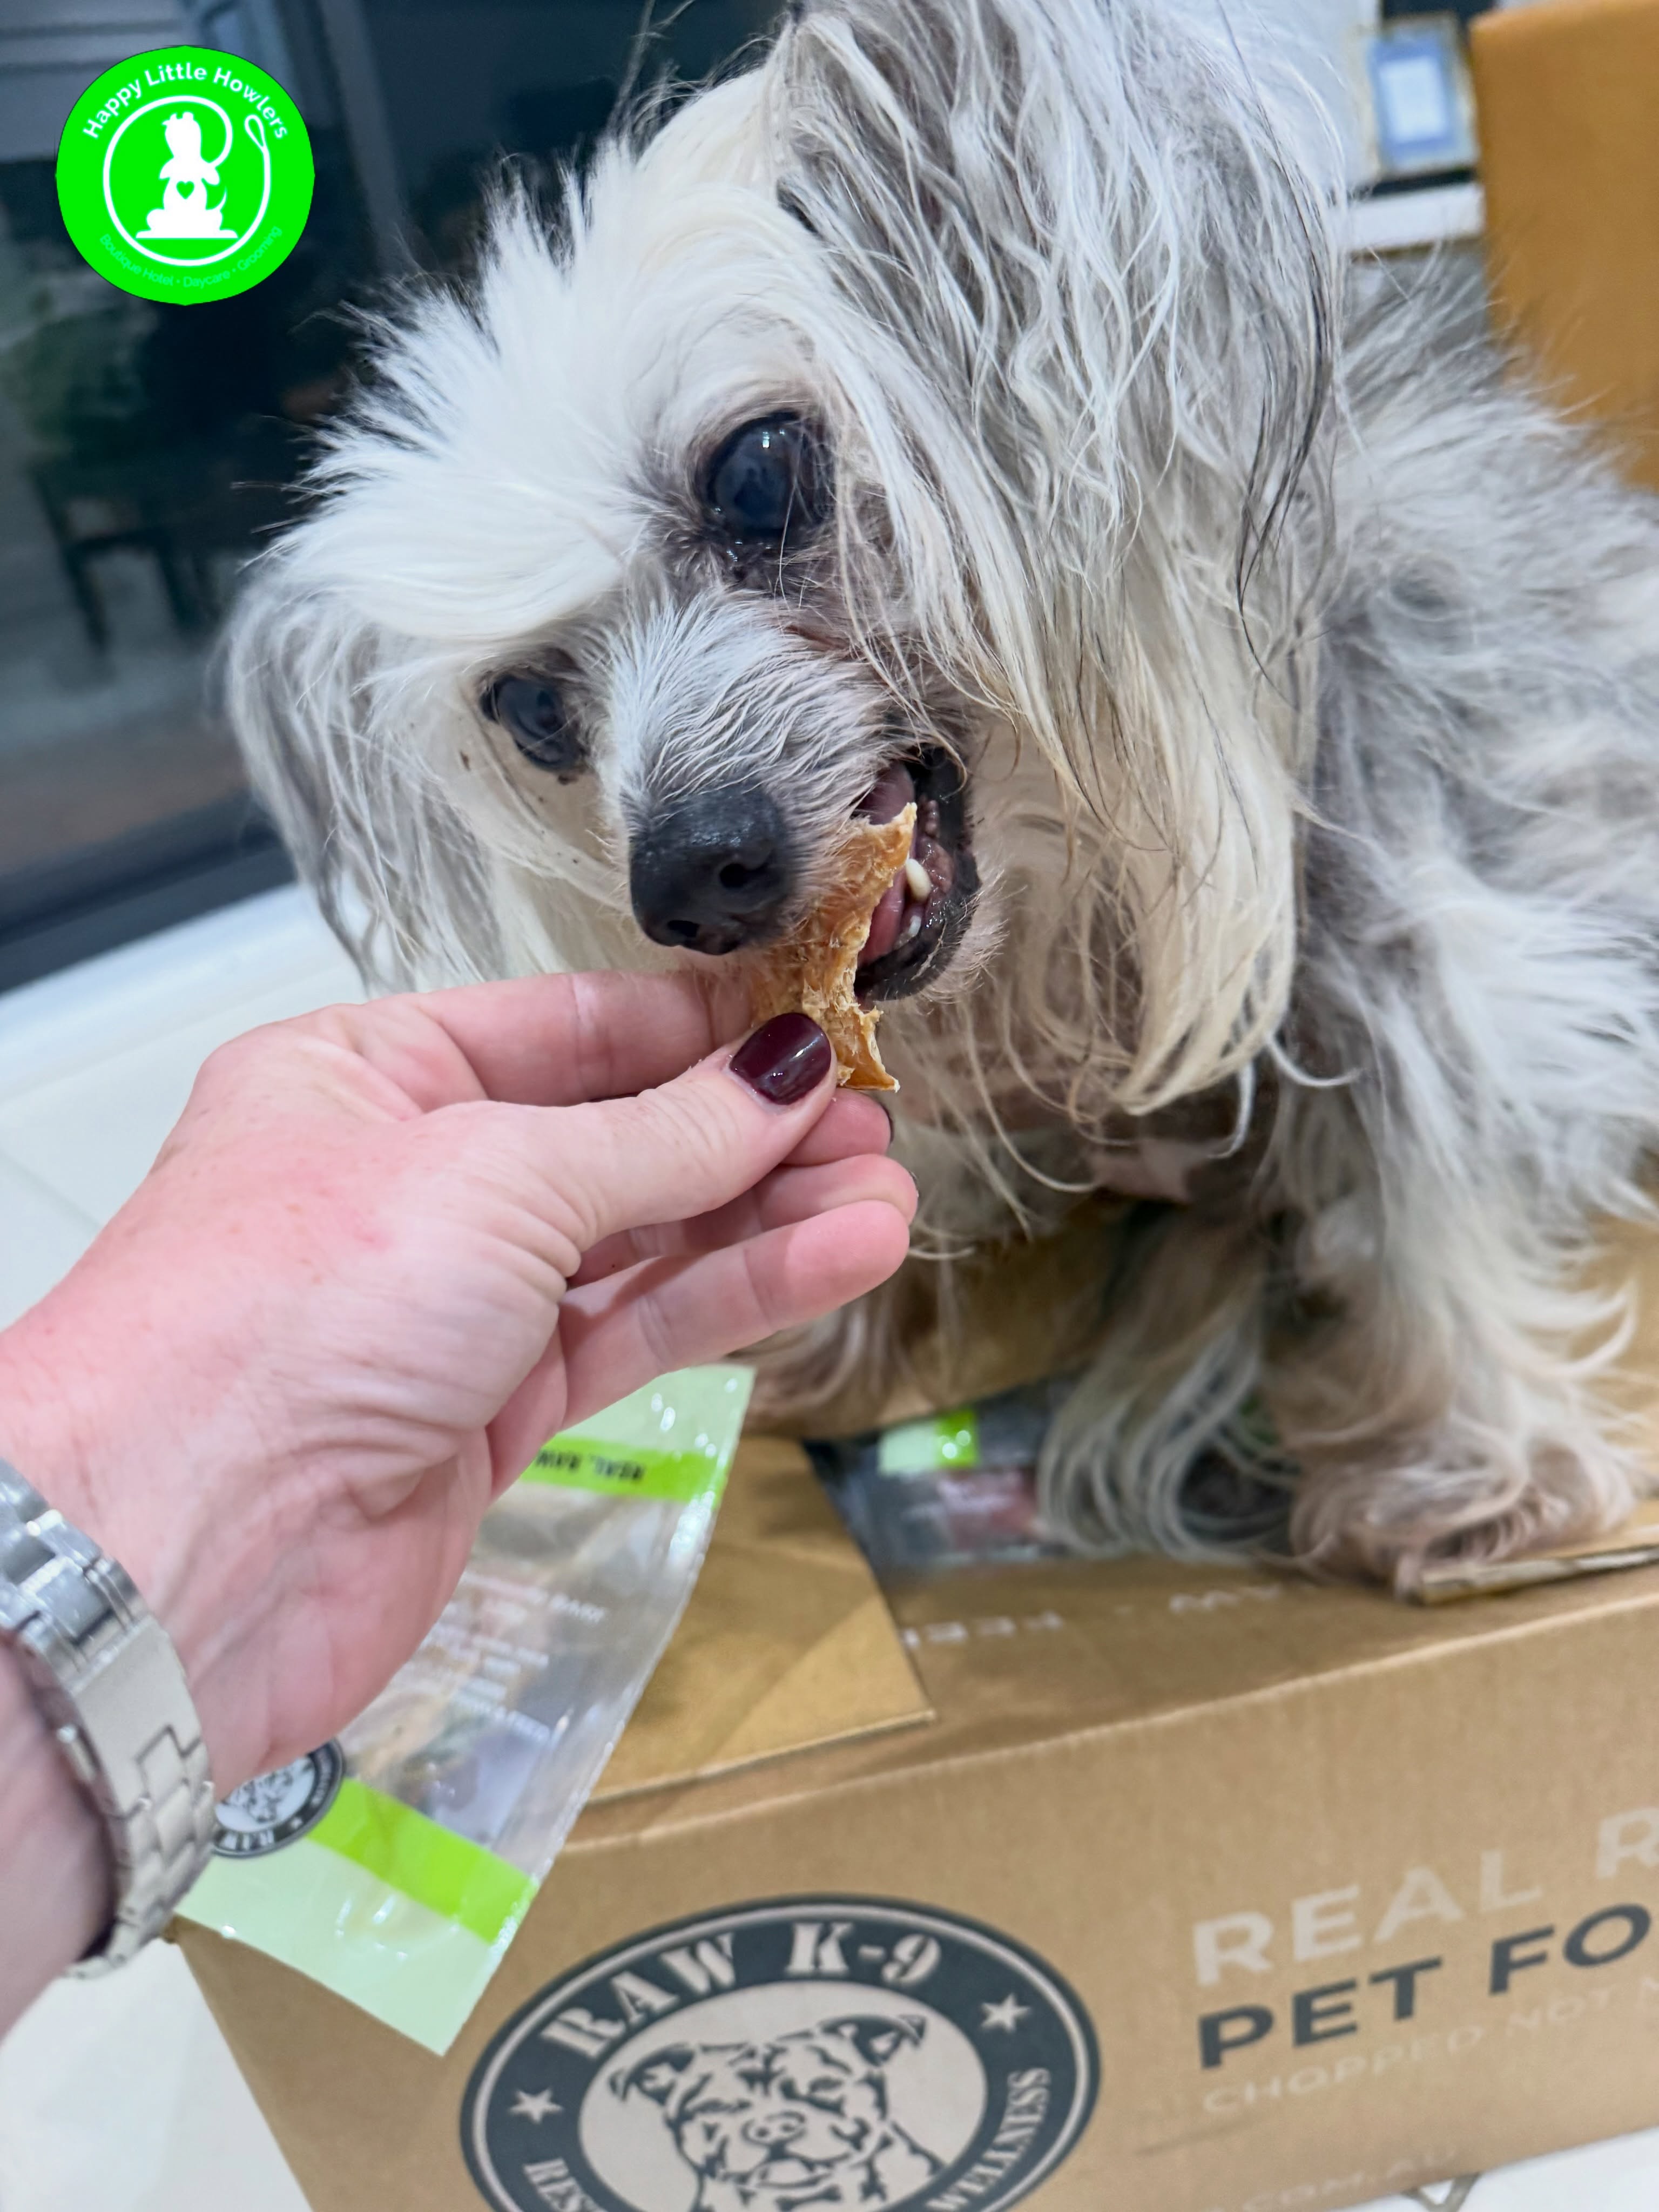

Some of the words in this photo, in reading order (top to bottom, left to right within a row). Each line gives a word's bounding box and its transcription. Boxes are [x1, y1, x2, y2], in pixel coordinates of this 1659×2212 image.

[1191, 1848, 1543, 1988] REAL
[1197, 1955, 1444, 2071] PET
[1487, 1902, 1653, 1997] FO
[540, 1932, 736, 2059] RAW
[783, 1921, 943, 1987] K-9
